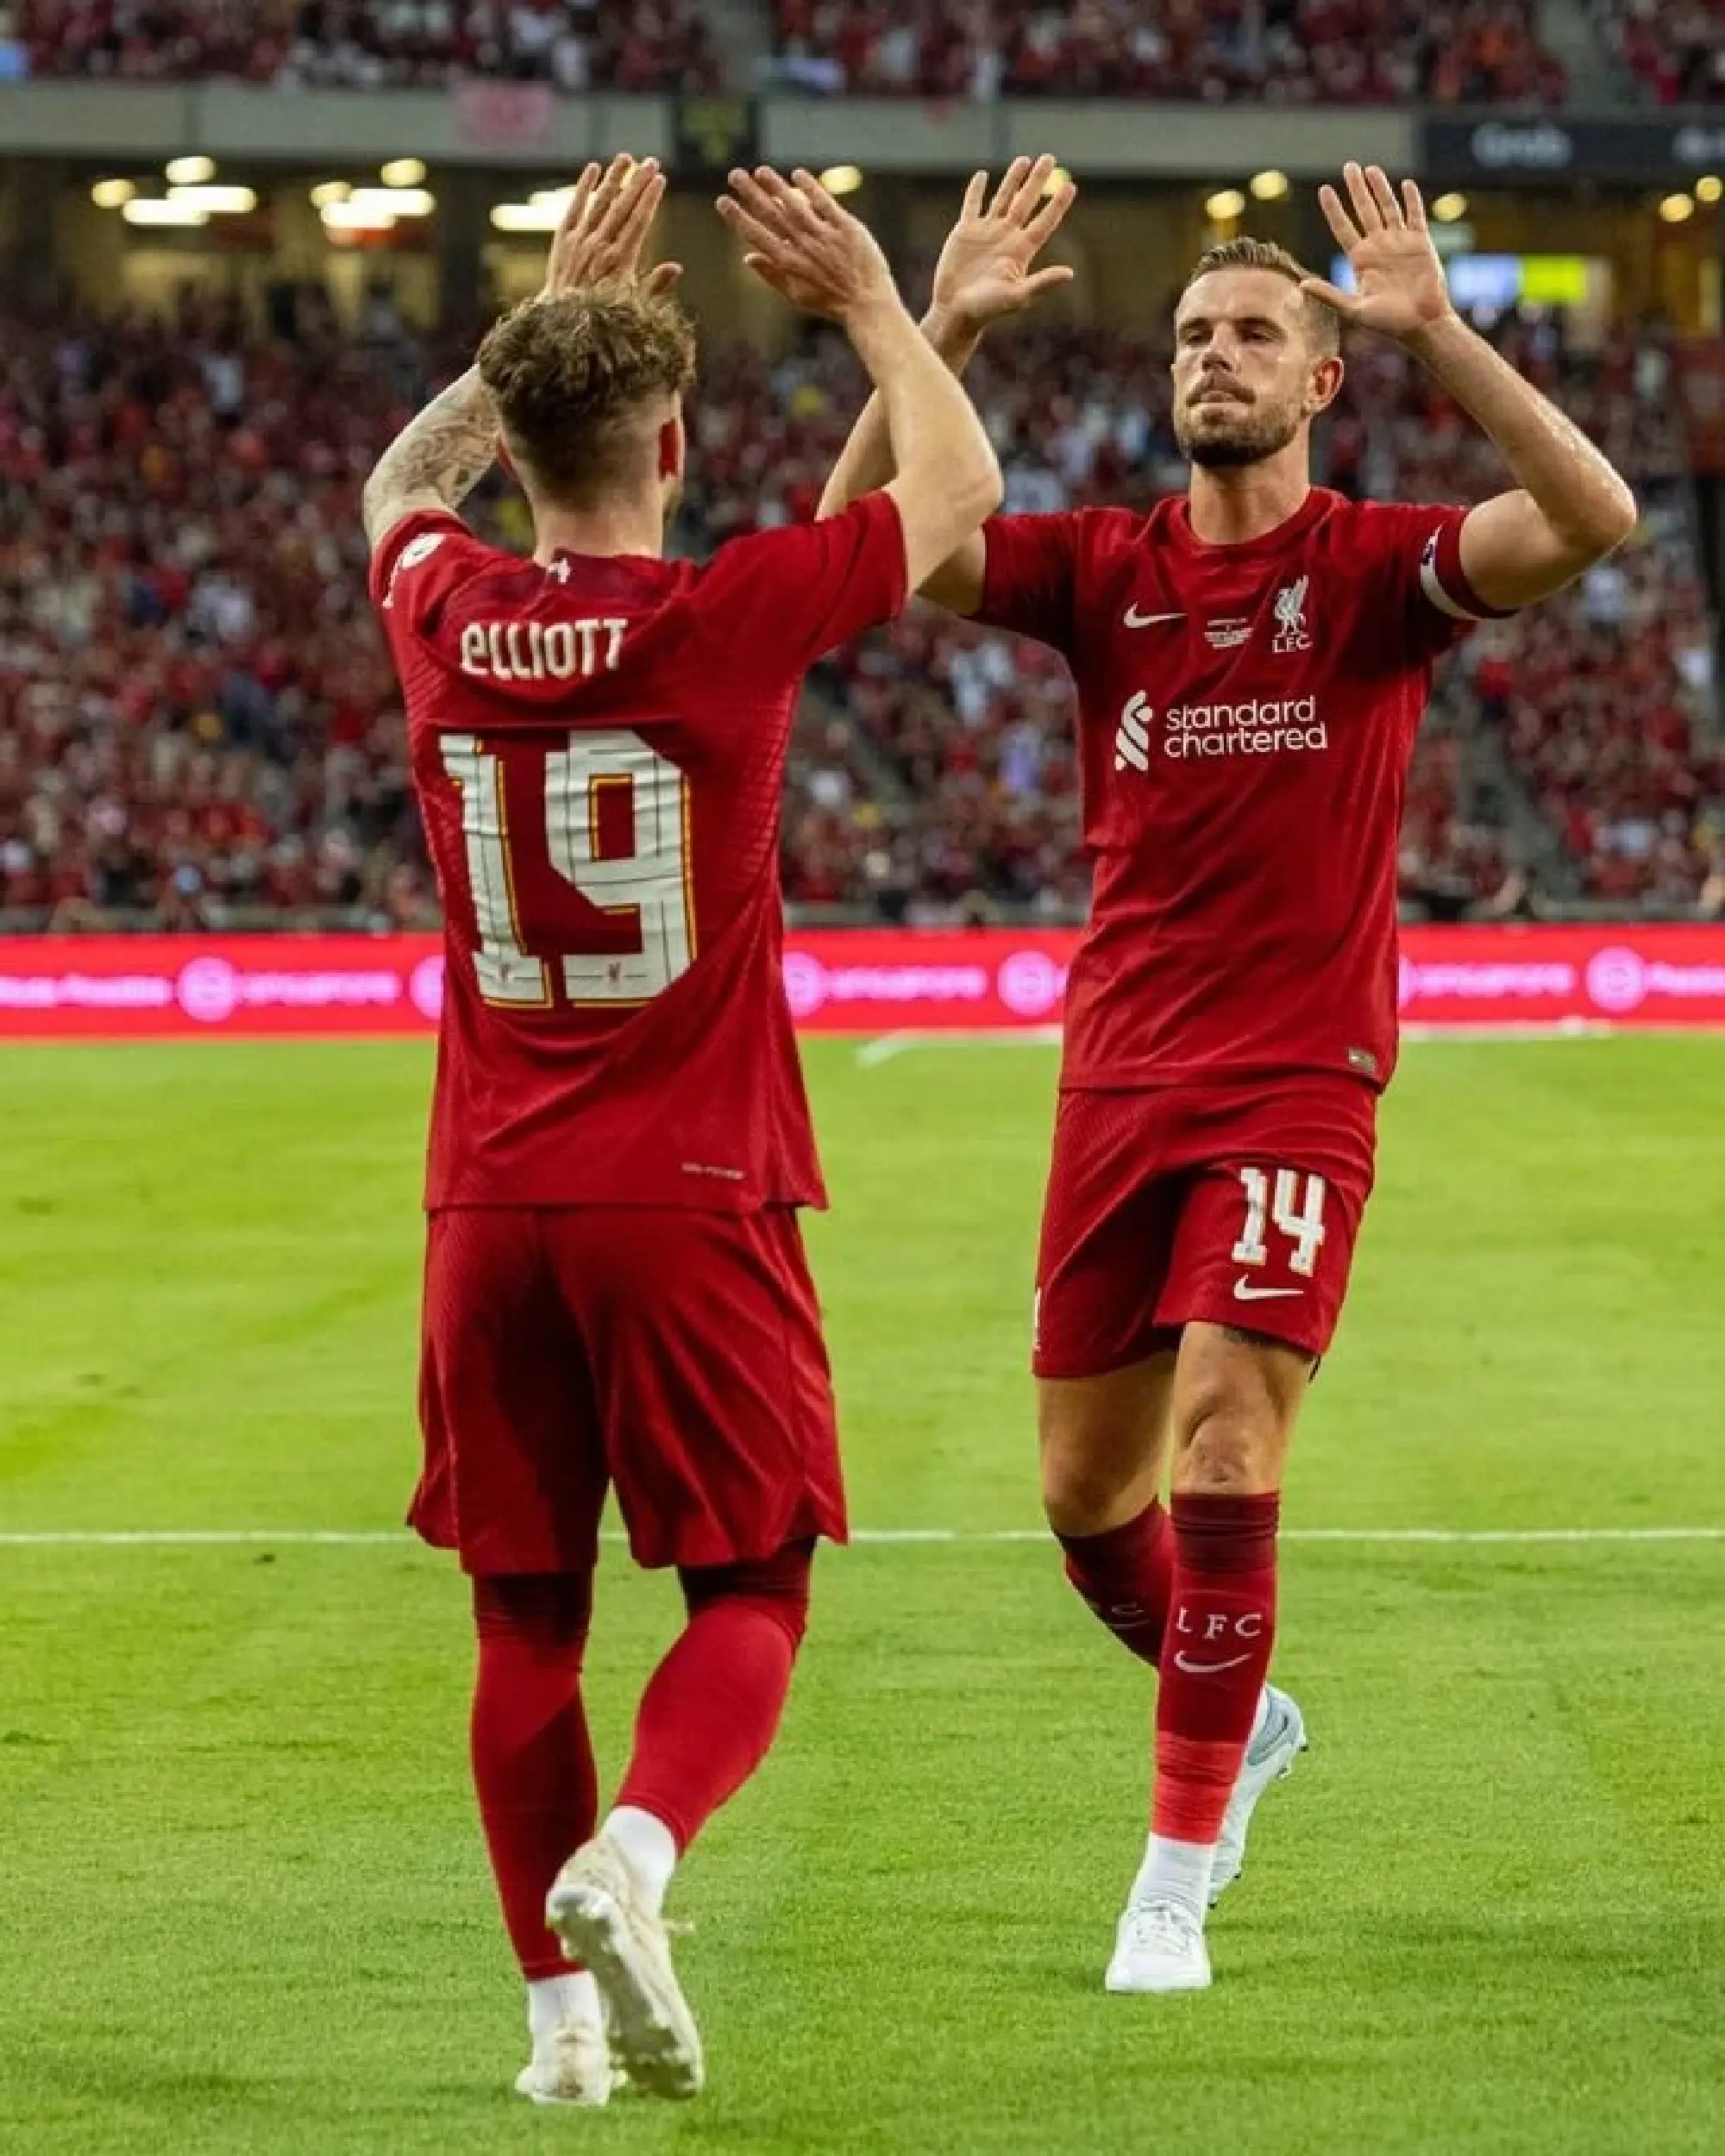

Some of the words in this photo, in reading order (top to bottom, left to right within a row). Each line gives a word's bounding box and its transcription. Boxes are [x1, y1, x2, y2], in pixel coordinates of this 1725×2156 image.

[1272, 631, 1313, 653] LFC
[1166, 695, 1315, 730] standard
[1164, 721, 1327, 759] chartered
[439, 729, 697, 1008] 19
[1232, 1168, 1326, 1277] 14
